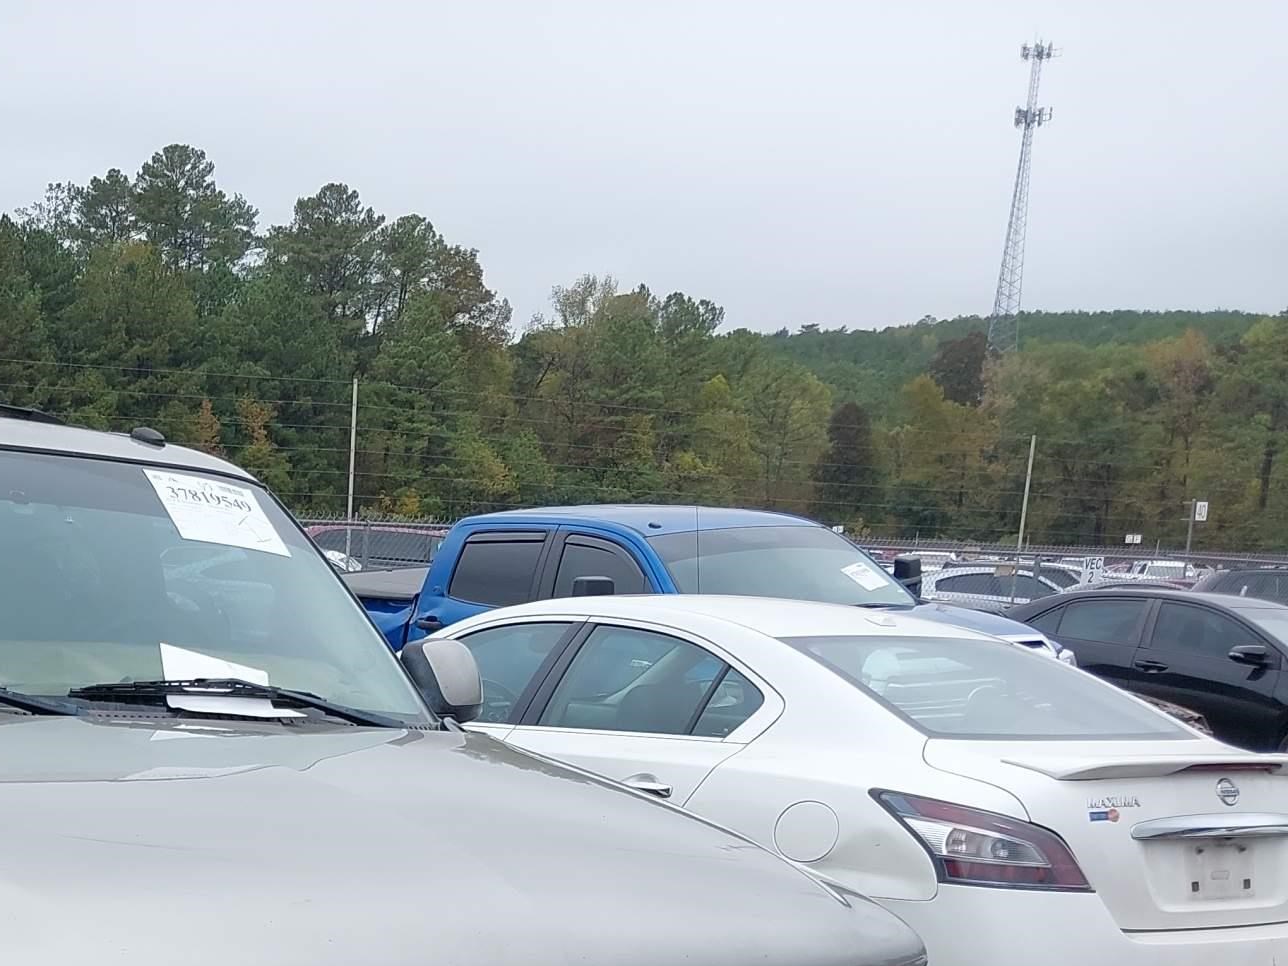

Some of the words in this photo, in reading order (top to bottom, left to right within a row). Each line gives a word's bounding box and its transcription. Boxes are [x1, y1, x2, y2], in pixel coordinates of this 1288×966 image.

[166, 486, 253, 513] 37819549
[1085, 558, 1102, 570] VEC
[1087, 571, 1094, 583] 2
